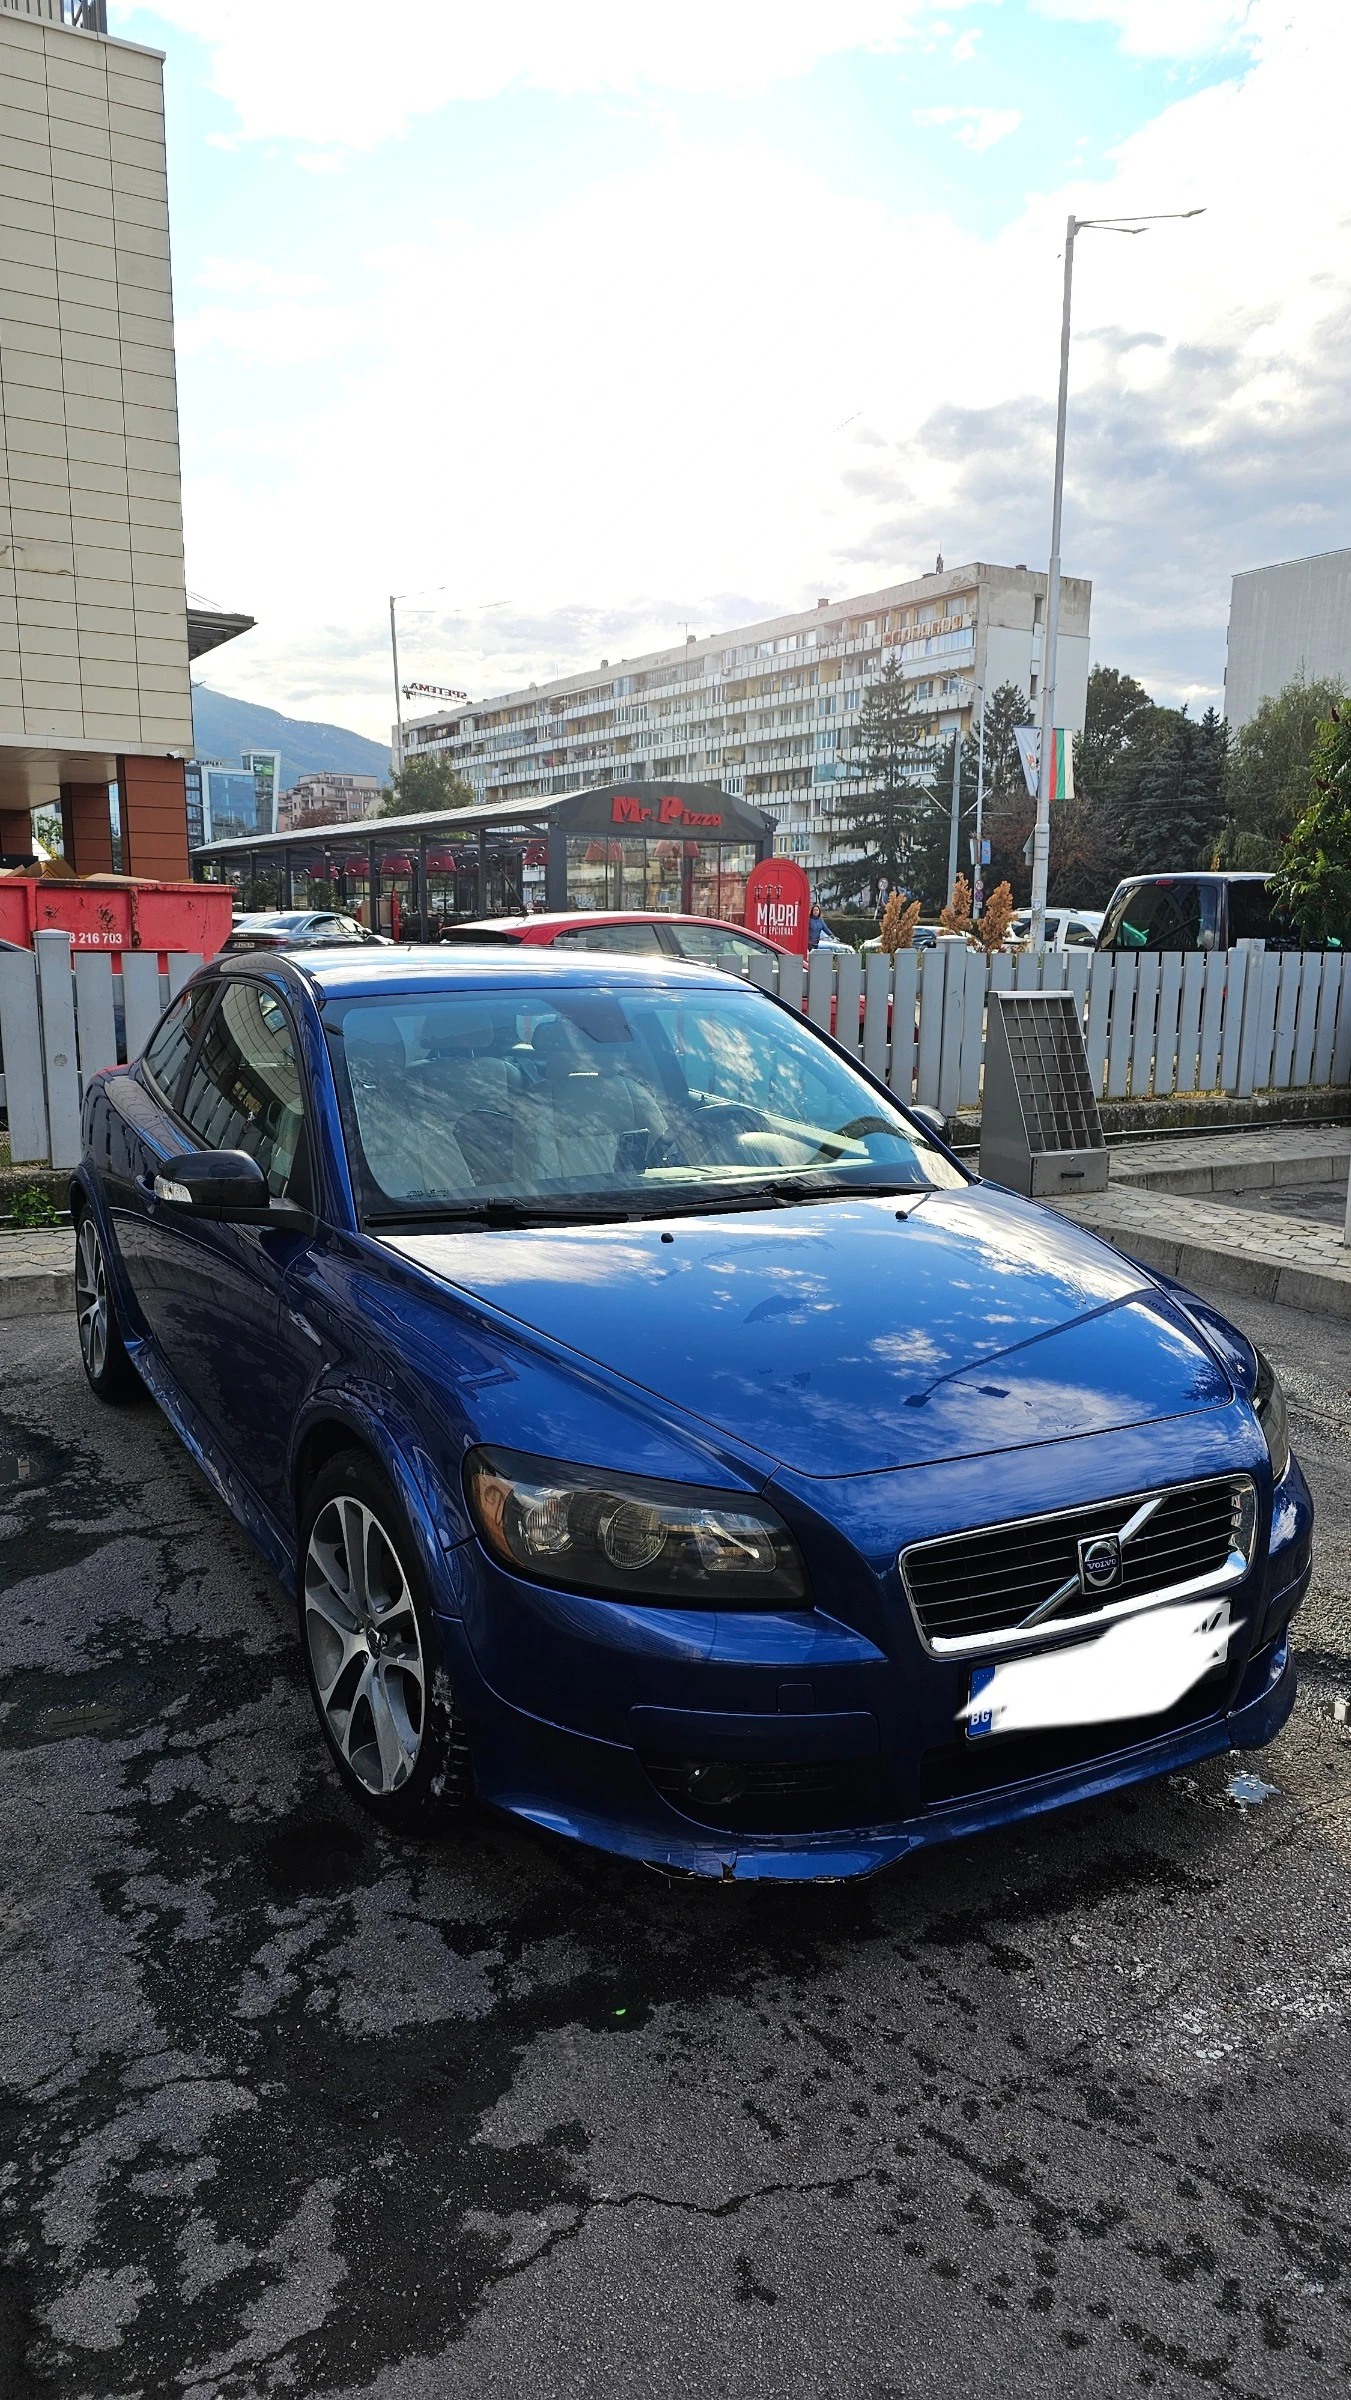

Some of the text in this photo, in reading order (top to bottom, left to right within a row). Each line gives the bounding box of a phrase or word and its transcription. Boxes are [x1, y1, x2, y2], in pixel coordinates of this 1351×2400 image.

[612, 796, 721, 826] Mr. Pizza
[757, 901, 799, 927] MADRÍ
[79, 932, 100, 944] 216
[102, 932, 123, 944] 703
[1086, 1558, 1117, 1570] VOLVO
[970, 1705, 990, 1726] BG
